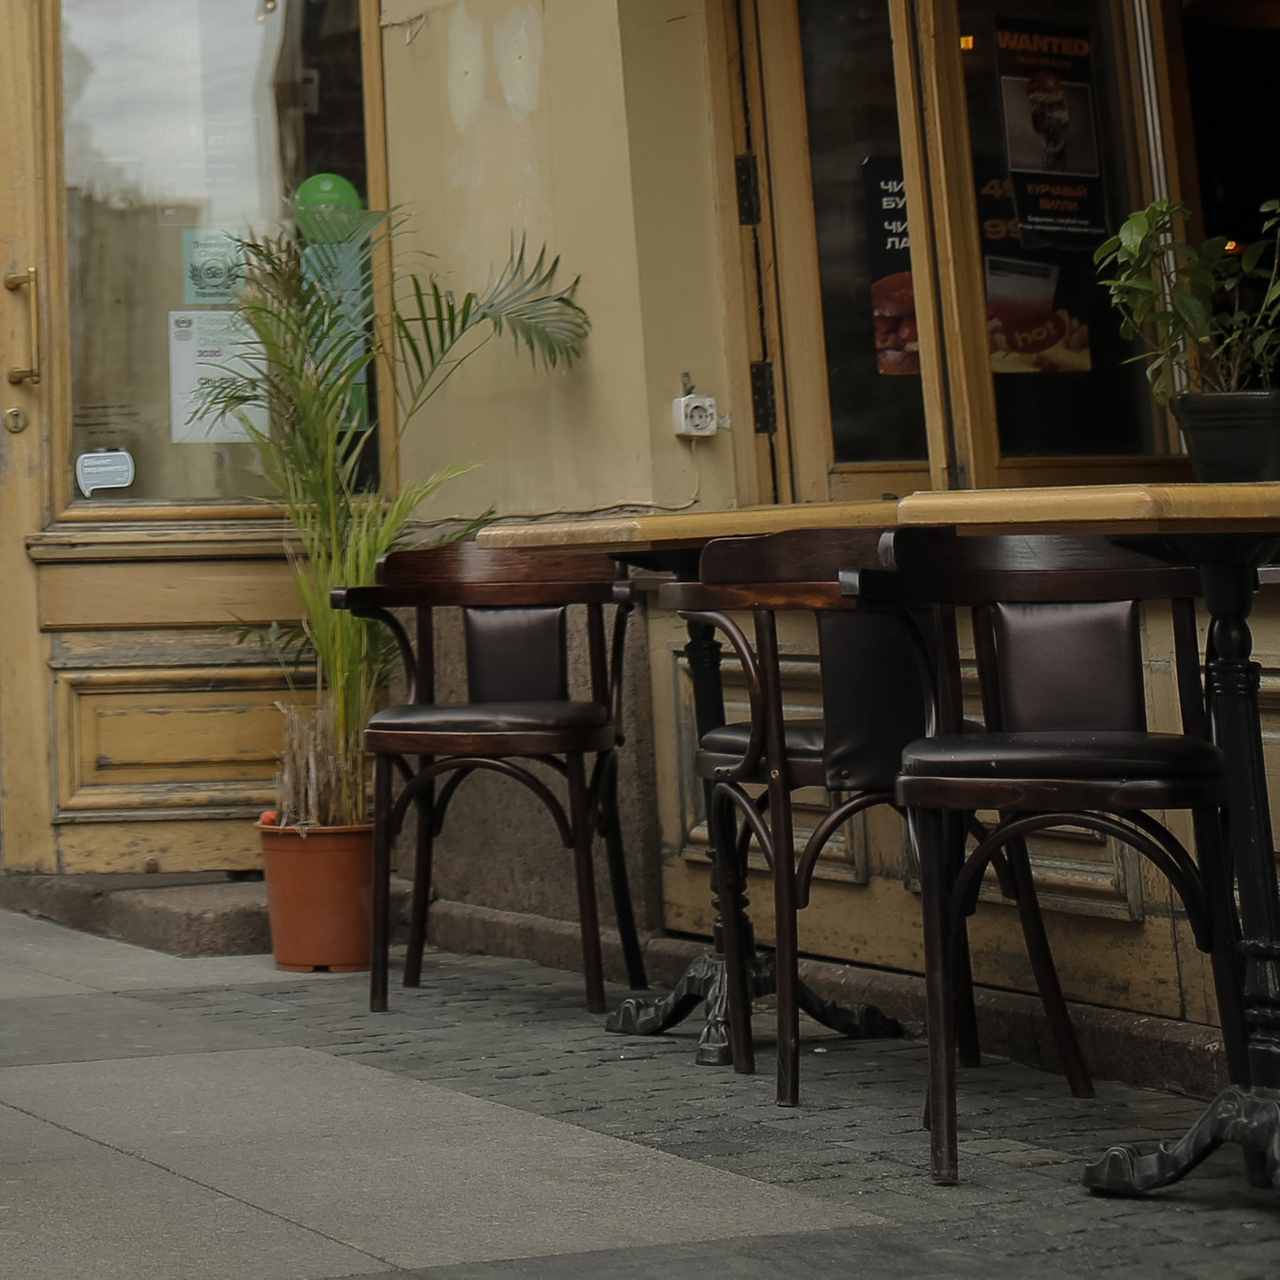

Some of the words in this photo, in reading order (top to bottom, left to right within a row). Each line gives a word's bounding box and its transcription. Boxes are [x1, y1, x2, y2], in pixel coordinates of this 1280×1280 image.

[997, 30, 1089, 56] WANTED
[1026, 183, 1088, 198] КУРЧАВЫЙ
[1039, 199, 1078, 211] БИЛЛИ
[1014, 320, 1058, 348] hot
